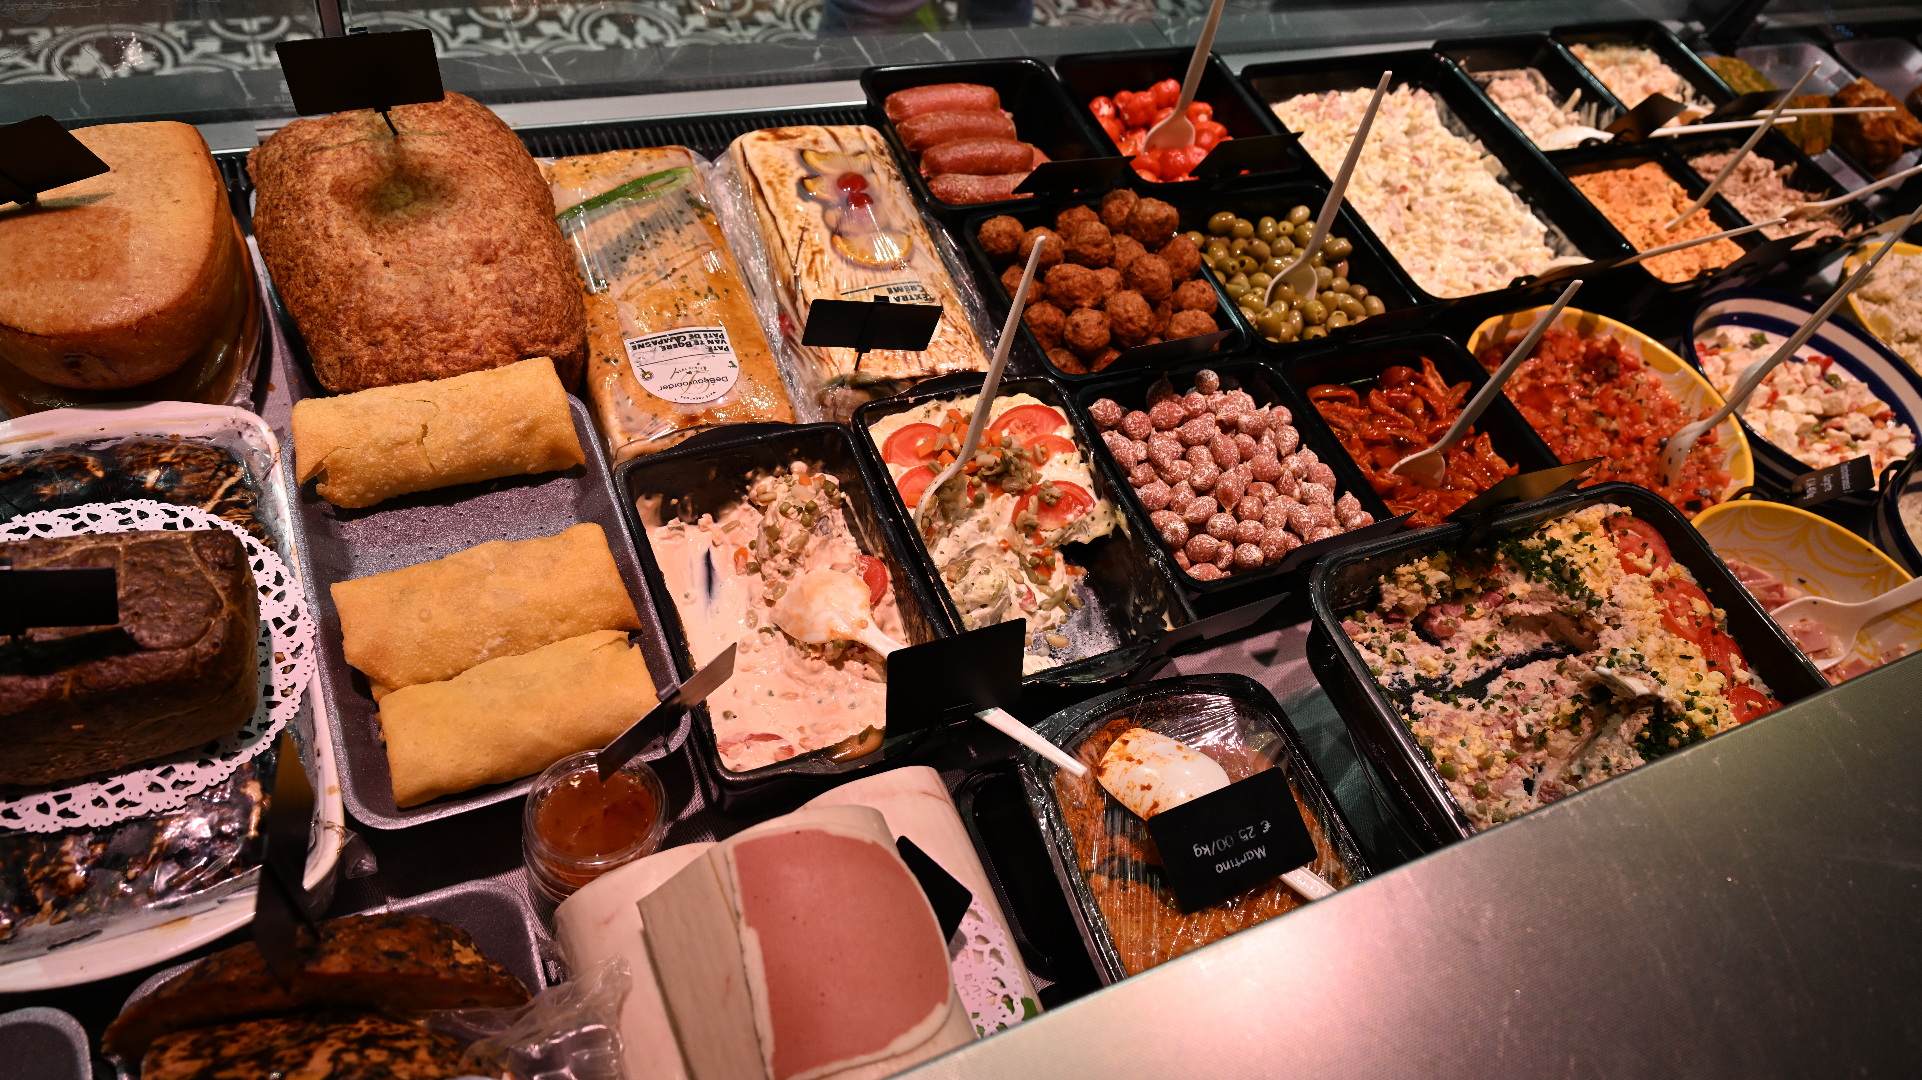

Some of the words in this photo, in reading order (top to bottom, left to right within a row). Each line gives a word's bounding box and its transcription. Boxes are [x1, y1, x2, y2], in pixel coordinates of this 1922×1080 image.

[893, 293, 932, 302] EXTRA
[632, 335, 687, 351] CAMPAGNE
[1260, 819, 1271, 834] €
[1215, 845, 1267, 874] Martino
